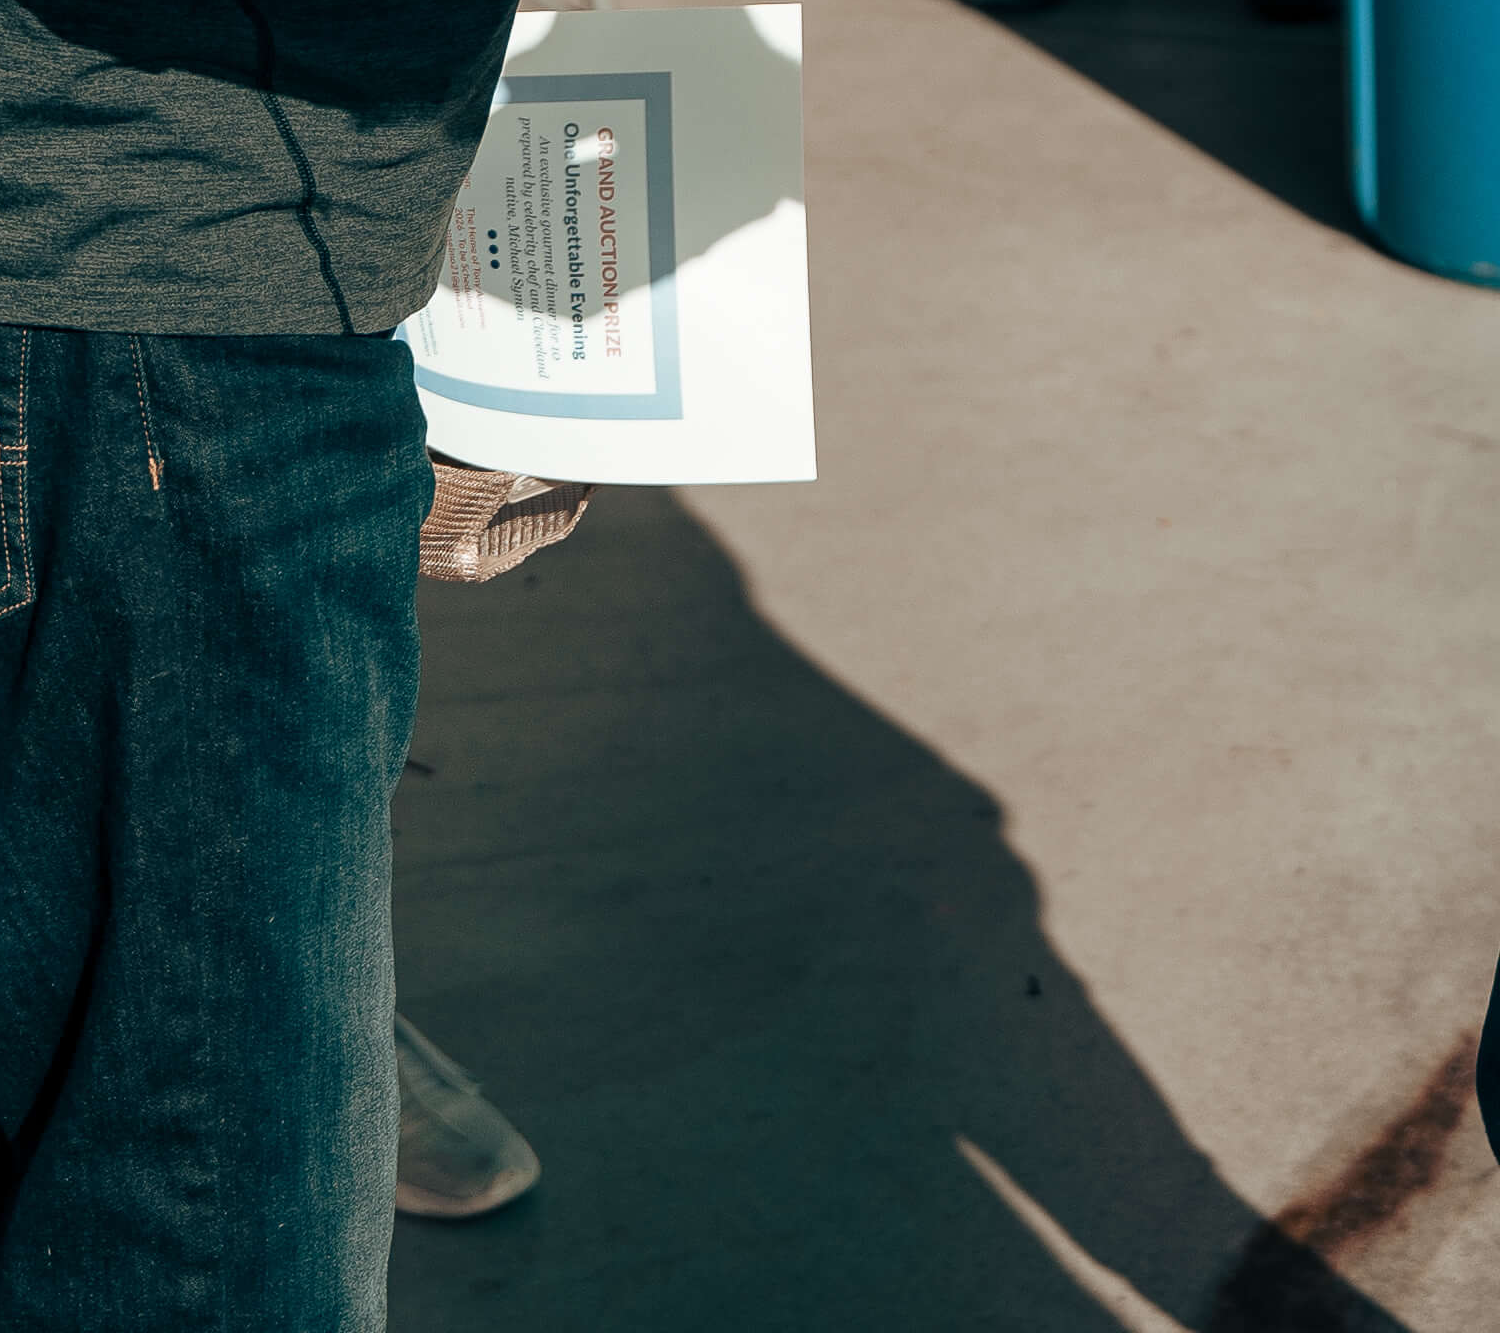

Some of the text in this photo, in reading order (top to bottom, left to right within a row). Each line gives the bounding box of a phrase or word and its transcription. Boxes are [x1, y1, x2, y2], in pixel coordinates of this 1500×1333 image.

[540, 136, 551, 154] An
[540, 158, 553, 216] exclusive
[459, 239, 467, 249] To
[467, 207, 476, 224] The
[472, 256, 480, 265] of
[506, 177, 525, 321] native, Michael Symon
[519, 117, 549, 379] prepared by celebrity chef and Cleveland
[540, 220, 556, 275] gourmet
[563, 123, 588, 360] One Unforgettable Evening
[598, 128, 621, 357] GRAND AUCTION PRIZE
[545, 278, 558, 320] dinner
[548, 323, 561, 342] for
